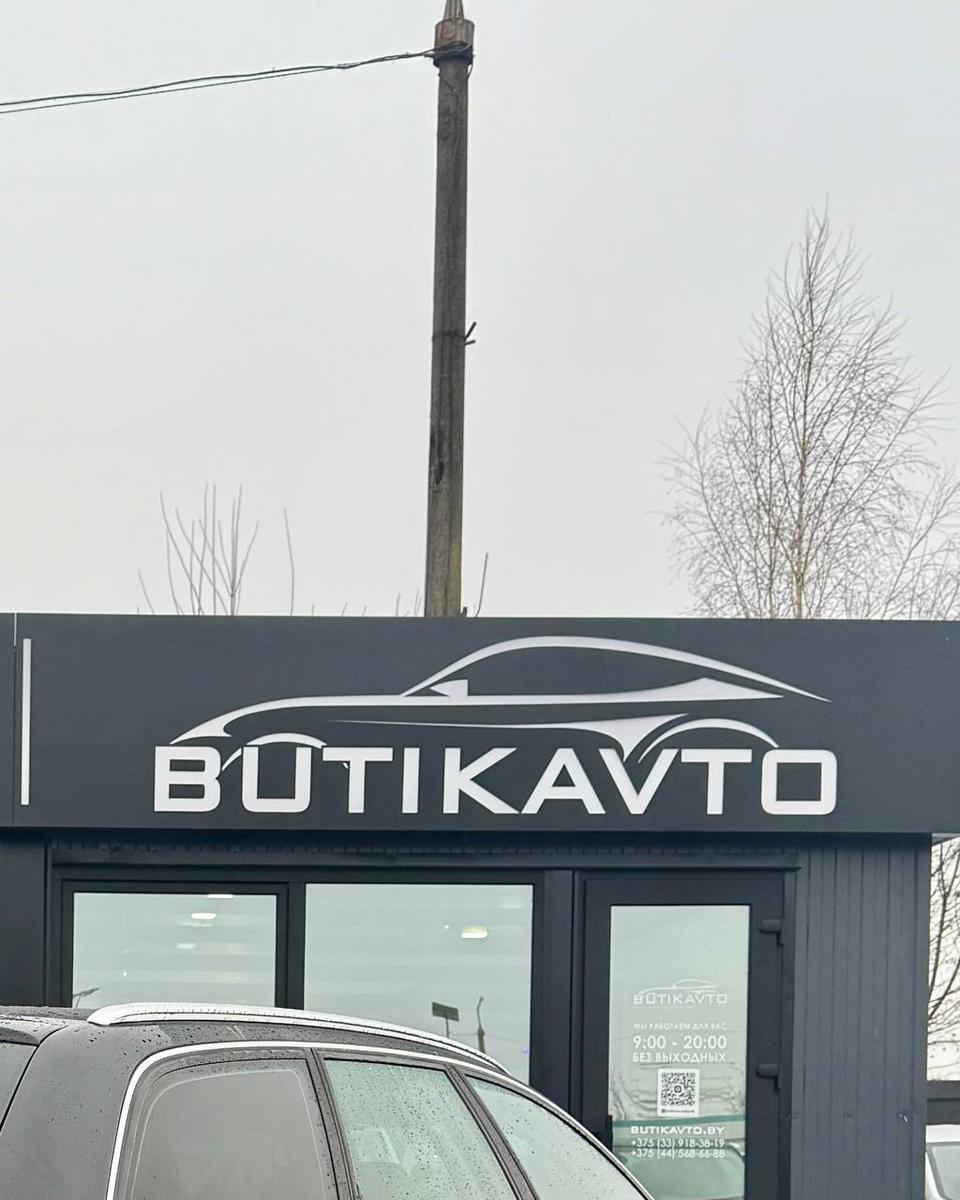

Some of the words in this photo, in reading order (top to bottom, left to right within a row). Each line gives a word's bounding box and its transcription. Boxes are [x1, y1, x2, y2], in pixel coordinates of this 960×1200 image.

[152, 743, 840, 818] BUTIKAVTO
[633, 993, 728, 1004] BUTIKAVTO
[633, 1035, 667, 1049] 9:00
[683, 1035, 728, 1049] 20:00
[632, 1052, 652, 1063] БЕЗ
[655, 1052, 727, 1063] ВЫХОДНЫХ
[630, 1125, 726, 1135] BUTIKAVTO.BY
[632, 1138, 655, 1148] +375
[657, 1138, 676, 1149] (33)
[677, 1138, 726, 1148] 918-38-19
[632, 1148, 655, 1158] +375
[657, 1148, 676, 1160] (44)
